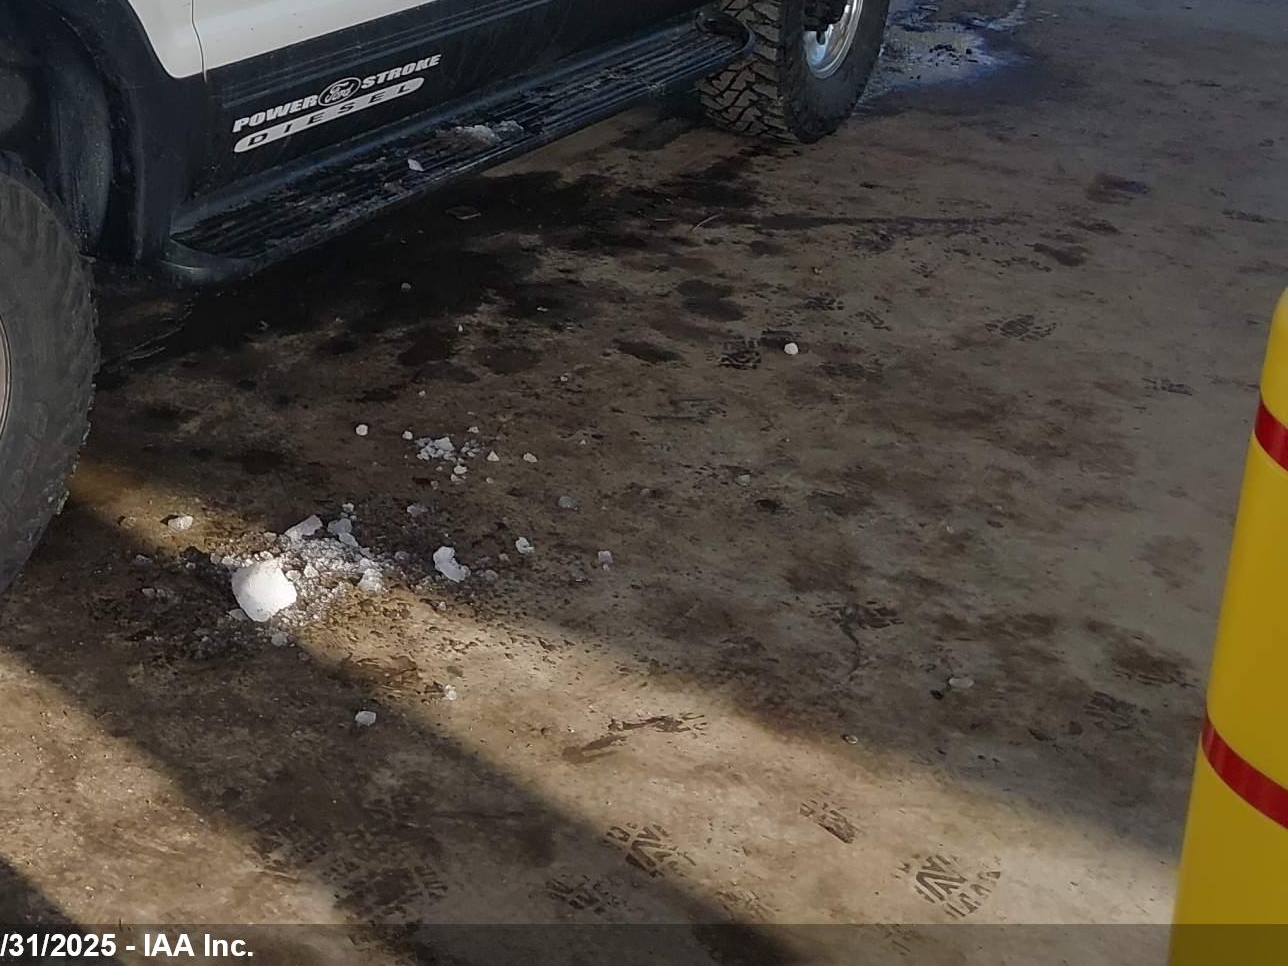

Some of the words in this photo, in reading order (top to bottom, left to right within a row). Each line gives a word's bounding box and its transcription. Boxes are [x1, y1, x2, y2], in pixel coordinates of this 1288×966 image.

[232, 95, 319, 133] POWER
[322, 79, 357, 105] Ford
[360, 54, 443, 90] STROKE
[247, 83, 411, 145] DIESEL
